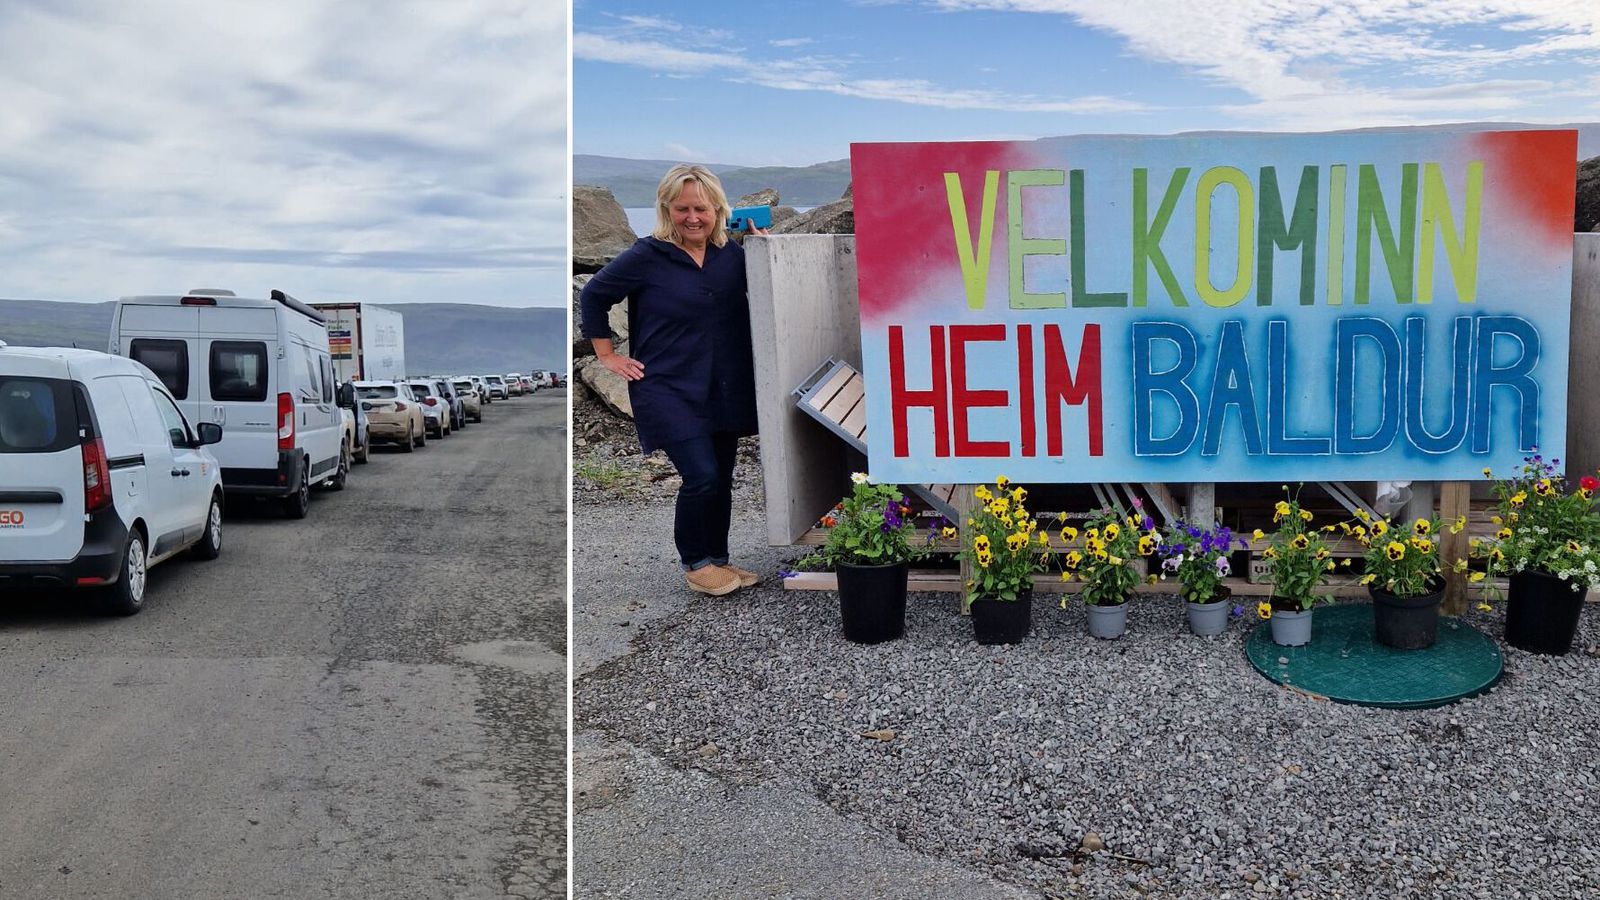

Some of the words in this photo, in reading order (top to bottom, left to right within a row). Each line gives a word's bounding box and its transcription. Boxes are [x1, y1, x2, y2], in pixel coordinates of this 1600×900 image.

[943, 161, 1484, 310] VELKOMINN
[888, 323, 1104, 457] HEIM
[1132, 315, 1541, 456] BALDUR
